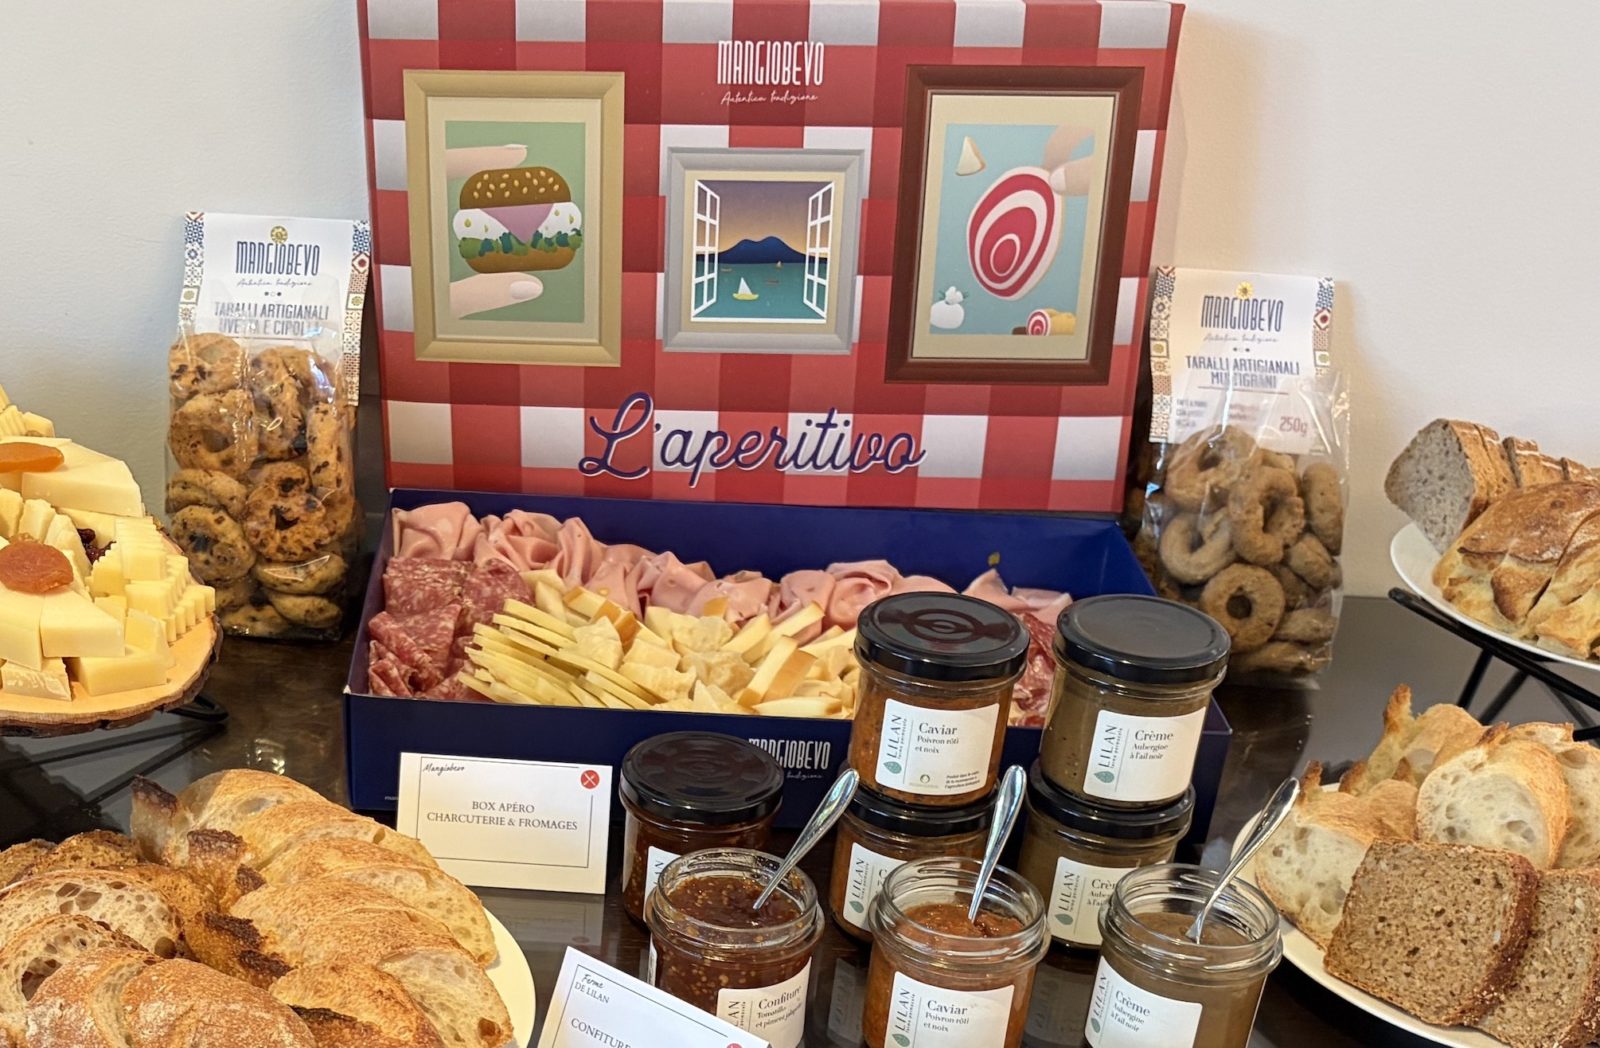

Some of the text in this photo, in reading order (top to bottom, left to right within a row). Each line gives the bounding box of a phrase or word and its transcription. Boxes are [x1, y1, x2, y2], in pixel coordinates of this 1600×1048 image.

[717, 40, 824, 86] MANGIOBEVO
[235, 240, 321, 276] MANGIOBEVO
[260, 303, 329, 320] ARTIGIANALI
[1201, 294, 1284, 332] MANGIOBEVO
[1186, 355, 1300, 375] TARALLI ARTIGIANALI
[1211, 372, 1277, 388] MUTIGRANI
[1279, 415, 1308, 437] 250g
[578, 391, 927, 489] L'aperitivo
[887, 714, 902, 759] LILAN
[918, 722, 958, 735] Caviar
[1134, 729, 1174, 742] Crème
[915, 745, 940, 754] et noix
[916, 735, 945, 745] Poivron
[1098, 725, 1118, 768] LILAN
[1133, 743, 1169, 751] Aubergine
[422, 763, 465, 776] Mangiobevo
[472, 800, 536, 814] BOX APÉRO
[427, 812, 579, 831] CHARCUTERIE & FROMAGES
[851, 857, 865, 898] LILAN
[1058, 871, 1075, 911] LILAN
[581, 973, 606, 989] Ferme
[574, 981, 610, 1004] DE LILAN
[895, 988, 910, 1032] LILAN
[927, 1000, 968, 1015] Caviar
[1115, 990, 1151, 1017] Crème
[923, 1022, 949, 1033] et noix
[925, 1012, 970, 1025] Poivron rôti
